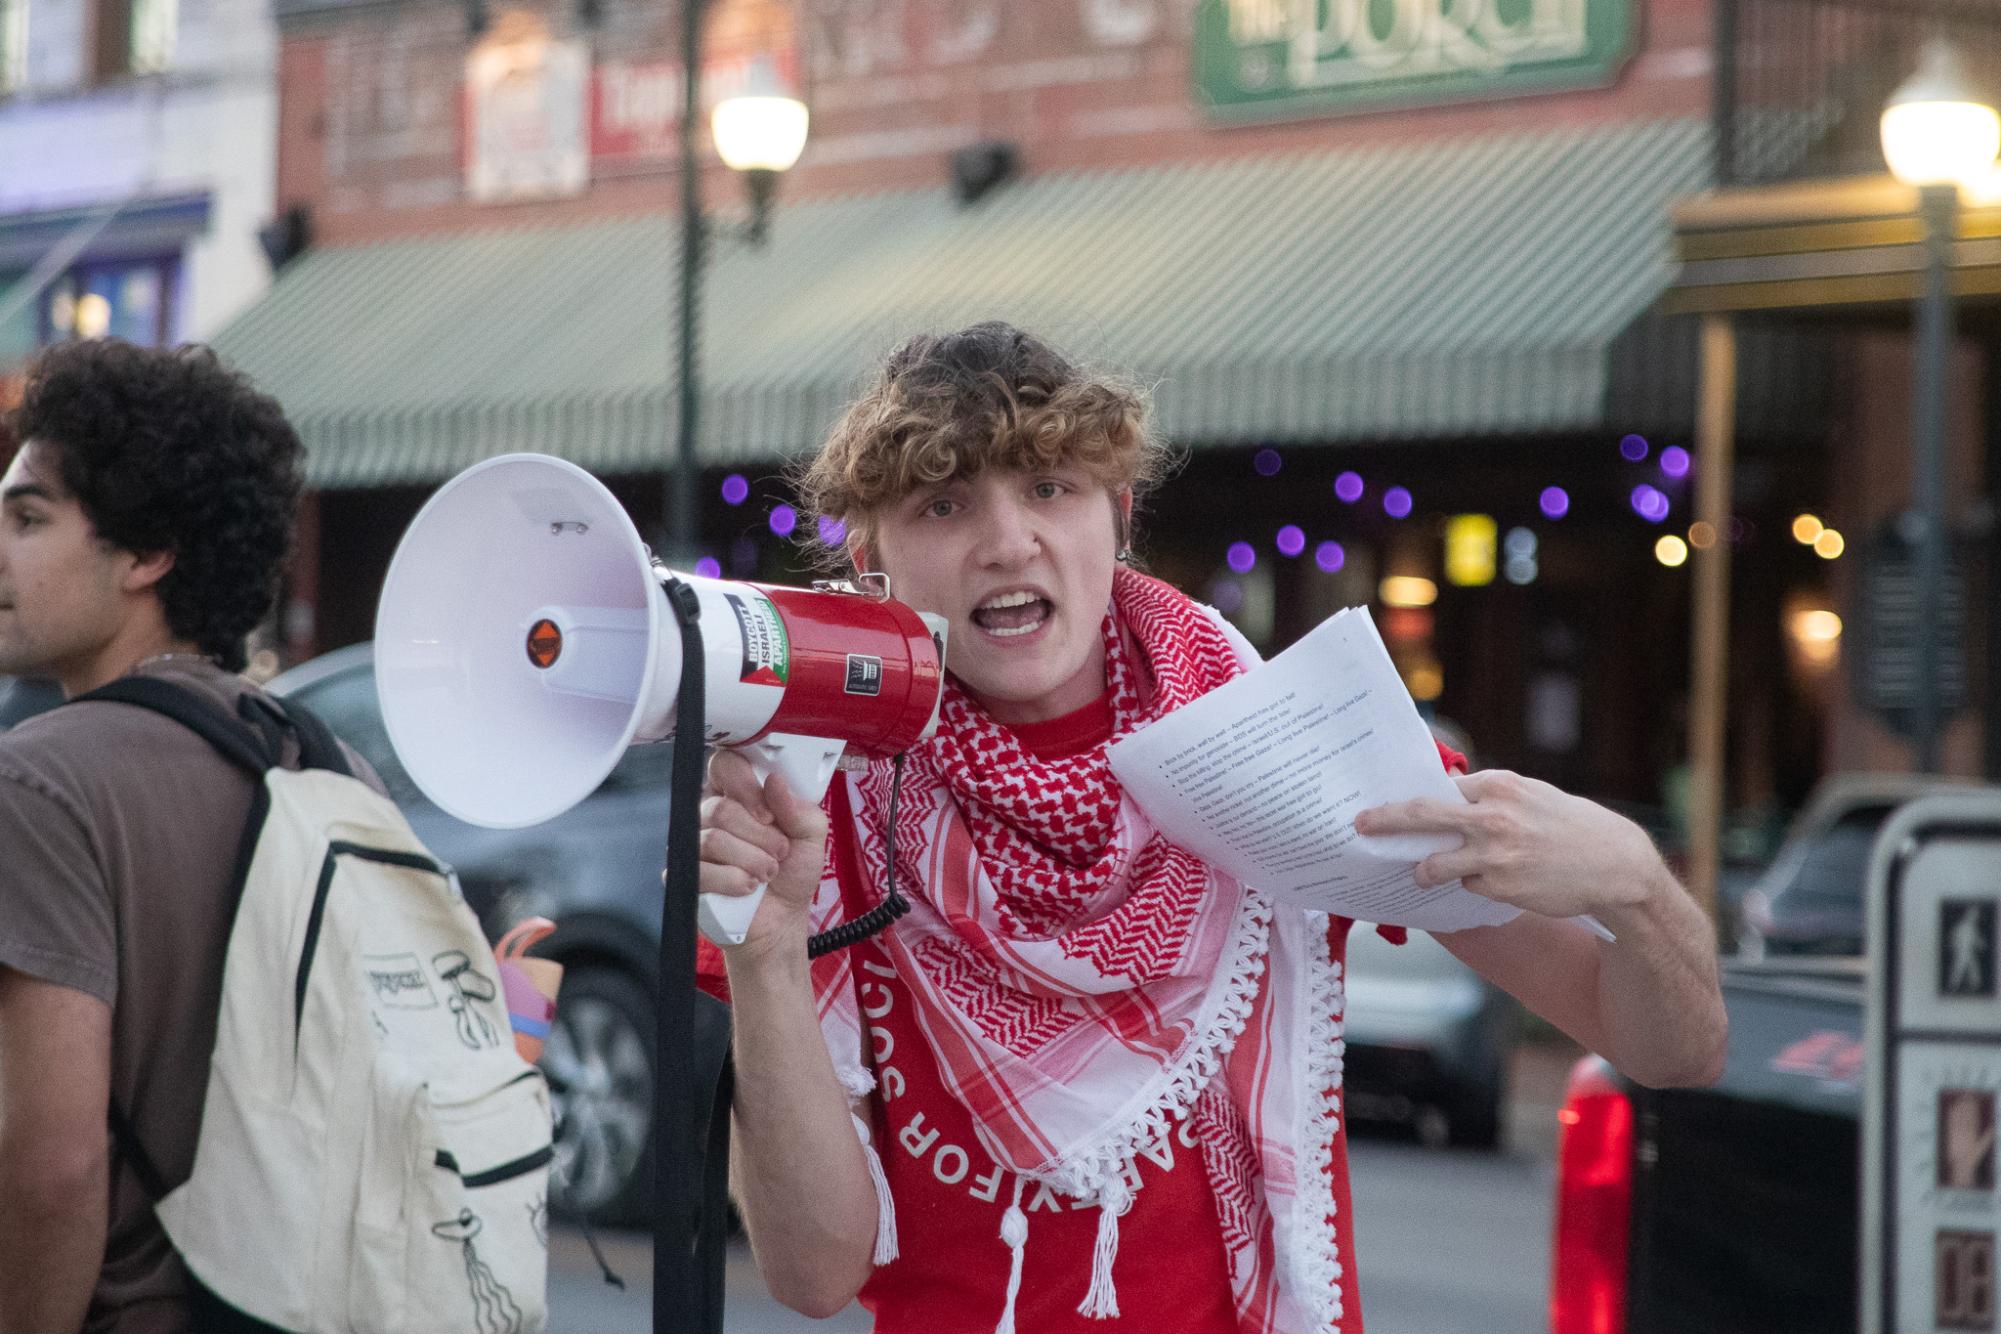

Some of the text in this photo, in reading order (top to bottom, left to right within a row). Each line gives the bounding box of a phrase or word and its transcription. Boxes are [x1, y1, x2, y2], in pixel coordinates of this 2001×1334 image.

[740, 603, 758, 662] BOYCOTT
[757, 615, 770, 663] ISRAELI
[759, 600, 784, 666] APARTHEID
[899, 1111, 1004, 1202] FOR
